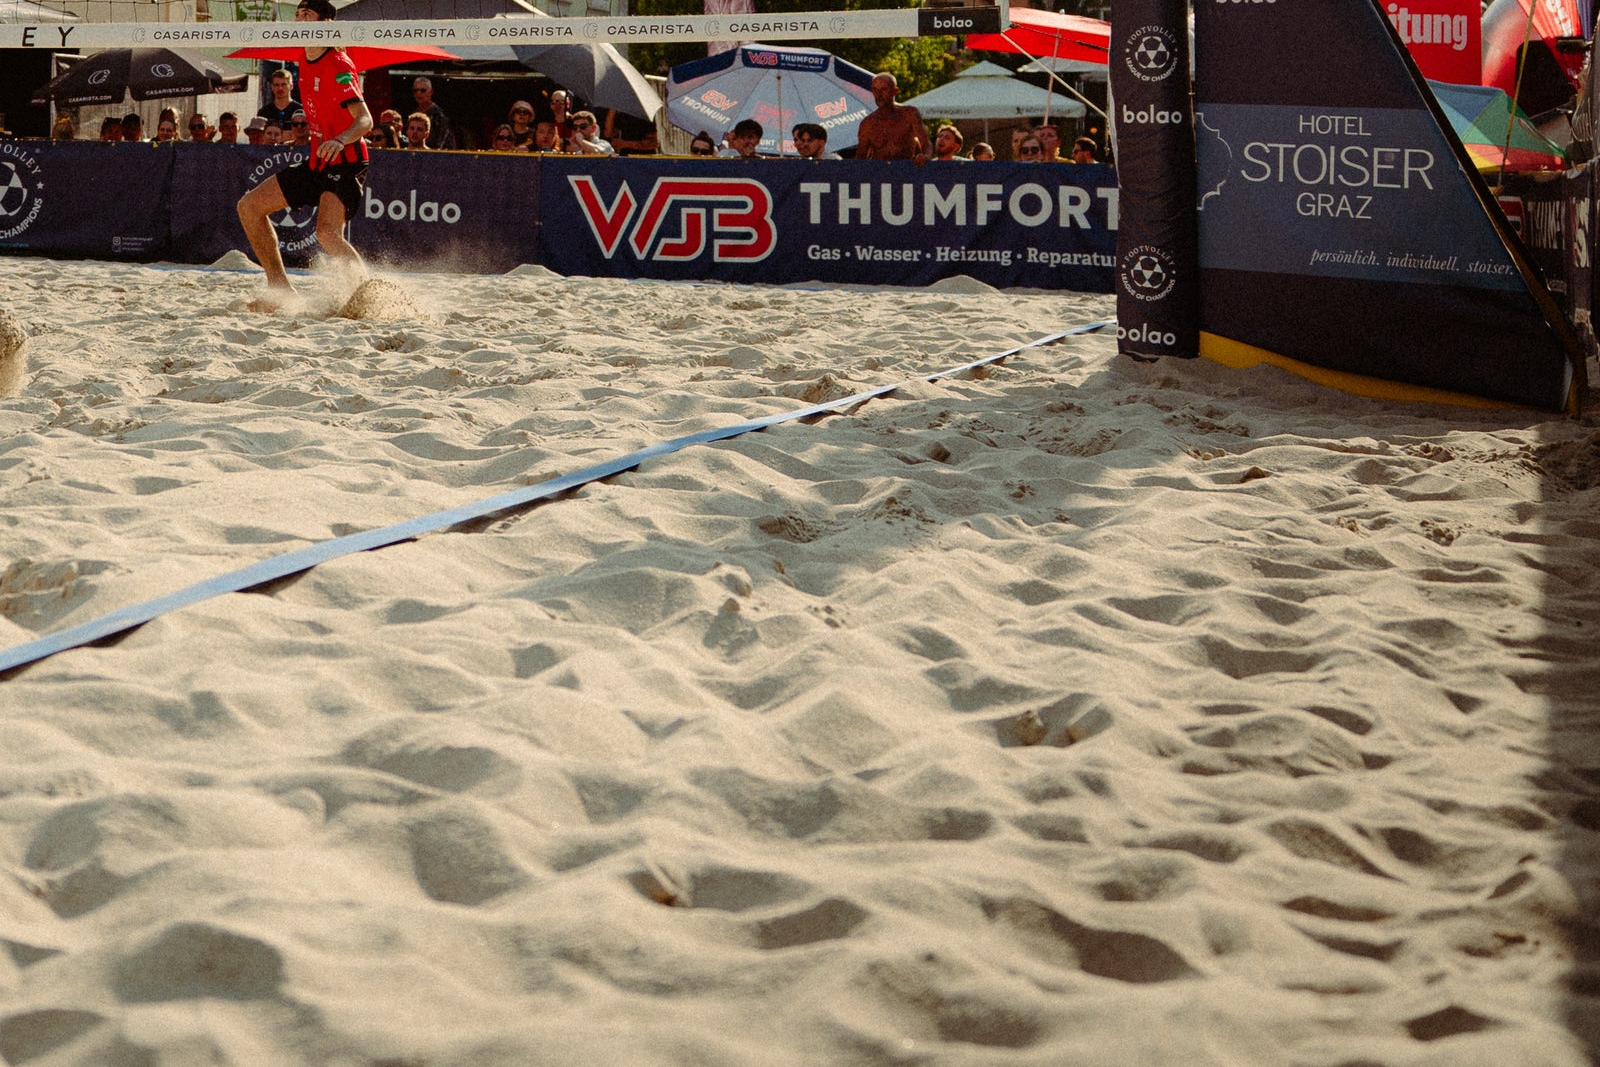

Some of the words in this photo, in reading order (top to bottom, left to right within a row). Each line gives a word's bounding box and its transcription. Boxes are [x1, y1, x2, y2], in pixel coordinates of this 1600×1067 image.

[152, 30, 232, 41] CASARISTA
[261, 29, 342, 40] CASARISTA
[373, 28, 456, 40] CASARISTA
[488, 25, 573, 38] CASARISTA
[607, 23, 695, 36] CASARISTA
[729, 21, 819, 33] CASARISTA
[933, 16, 973, 29] bolao
[1127, 25, 1177, 45] FOOTVOLLEY
[1388, 3, 1468, 52] itung
[780, 53, 825, 65] THUMFORT
[145, 86, 194, 96] CASARISTA.COM
[1122, 103, 1183, 124] bolao
[1299, 114, 1372, 136] HOTEL
[1240, 141, 1435, 190] STOISER
[364, 186, 462, 224] bolao
[799, 182, 1120, 231] THUMFORT
[1296, 192, 1373, 220] GRAZ
[807, 244, 842, 261] Gas
[855, 245, 922, 263] Wasser
[935, 246, 1012, 266] Heizung
[1124, 245, 1176, 266] FOOTVOLLEY
[1309, 248, 1380, 267] persönlich.
[1386, 251, 1460, 272] individuell.
[1466, 257, 1515, 276] stoiser.
